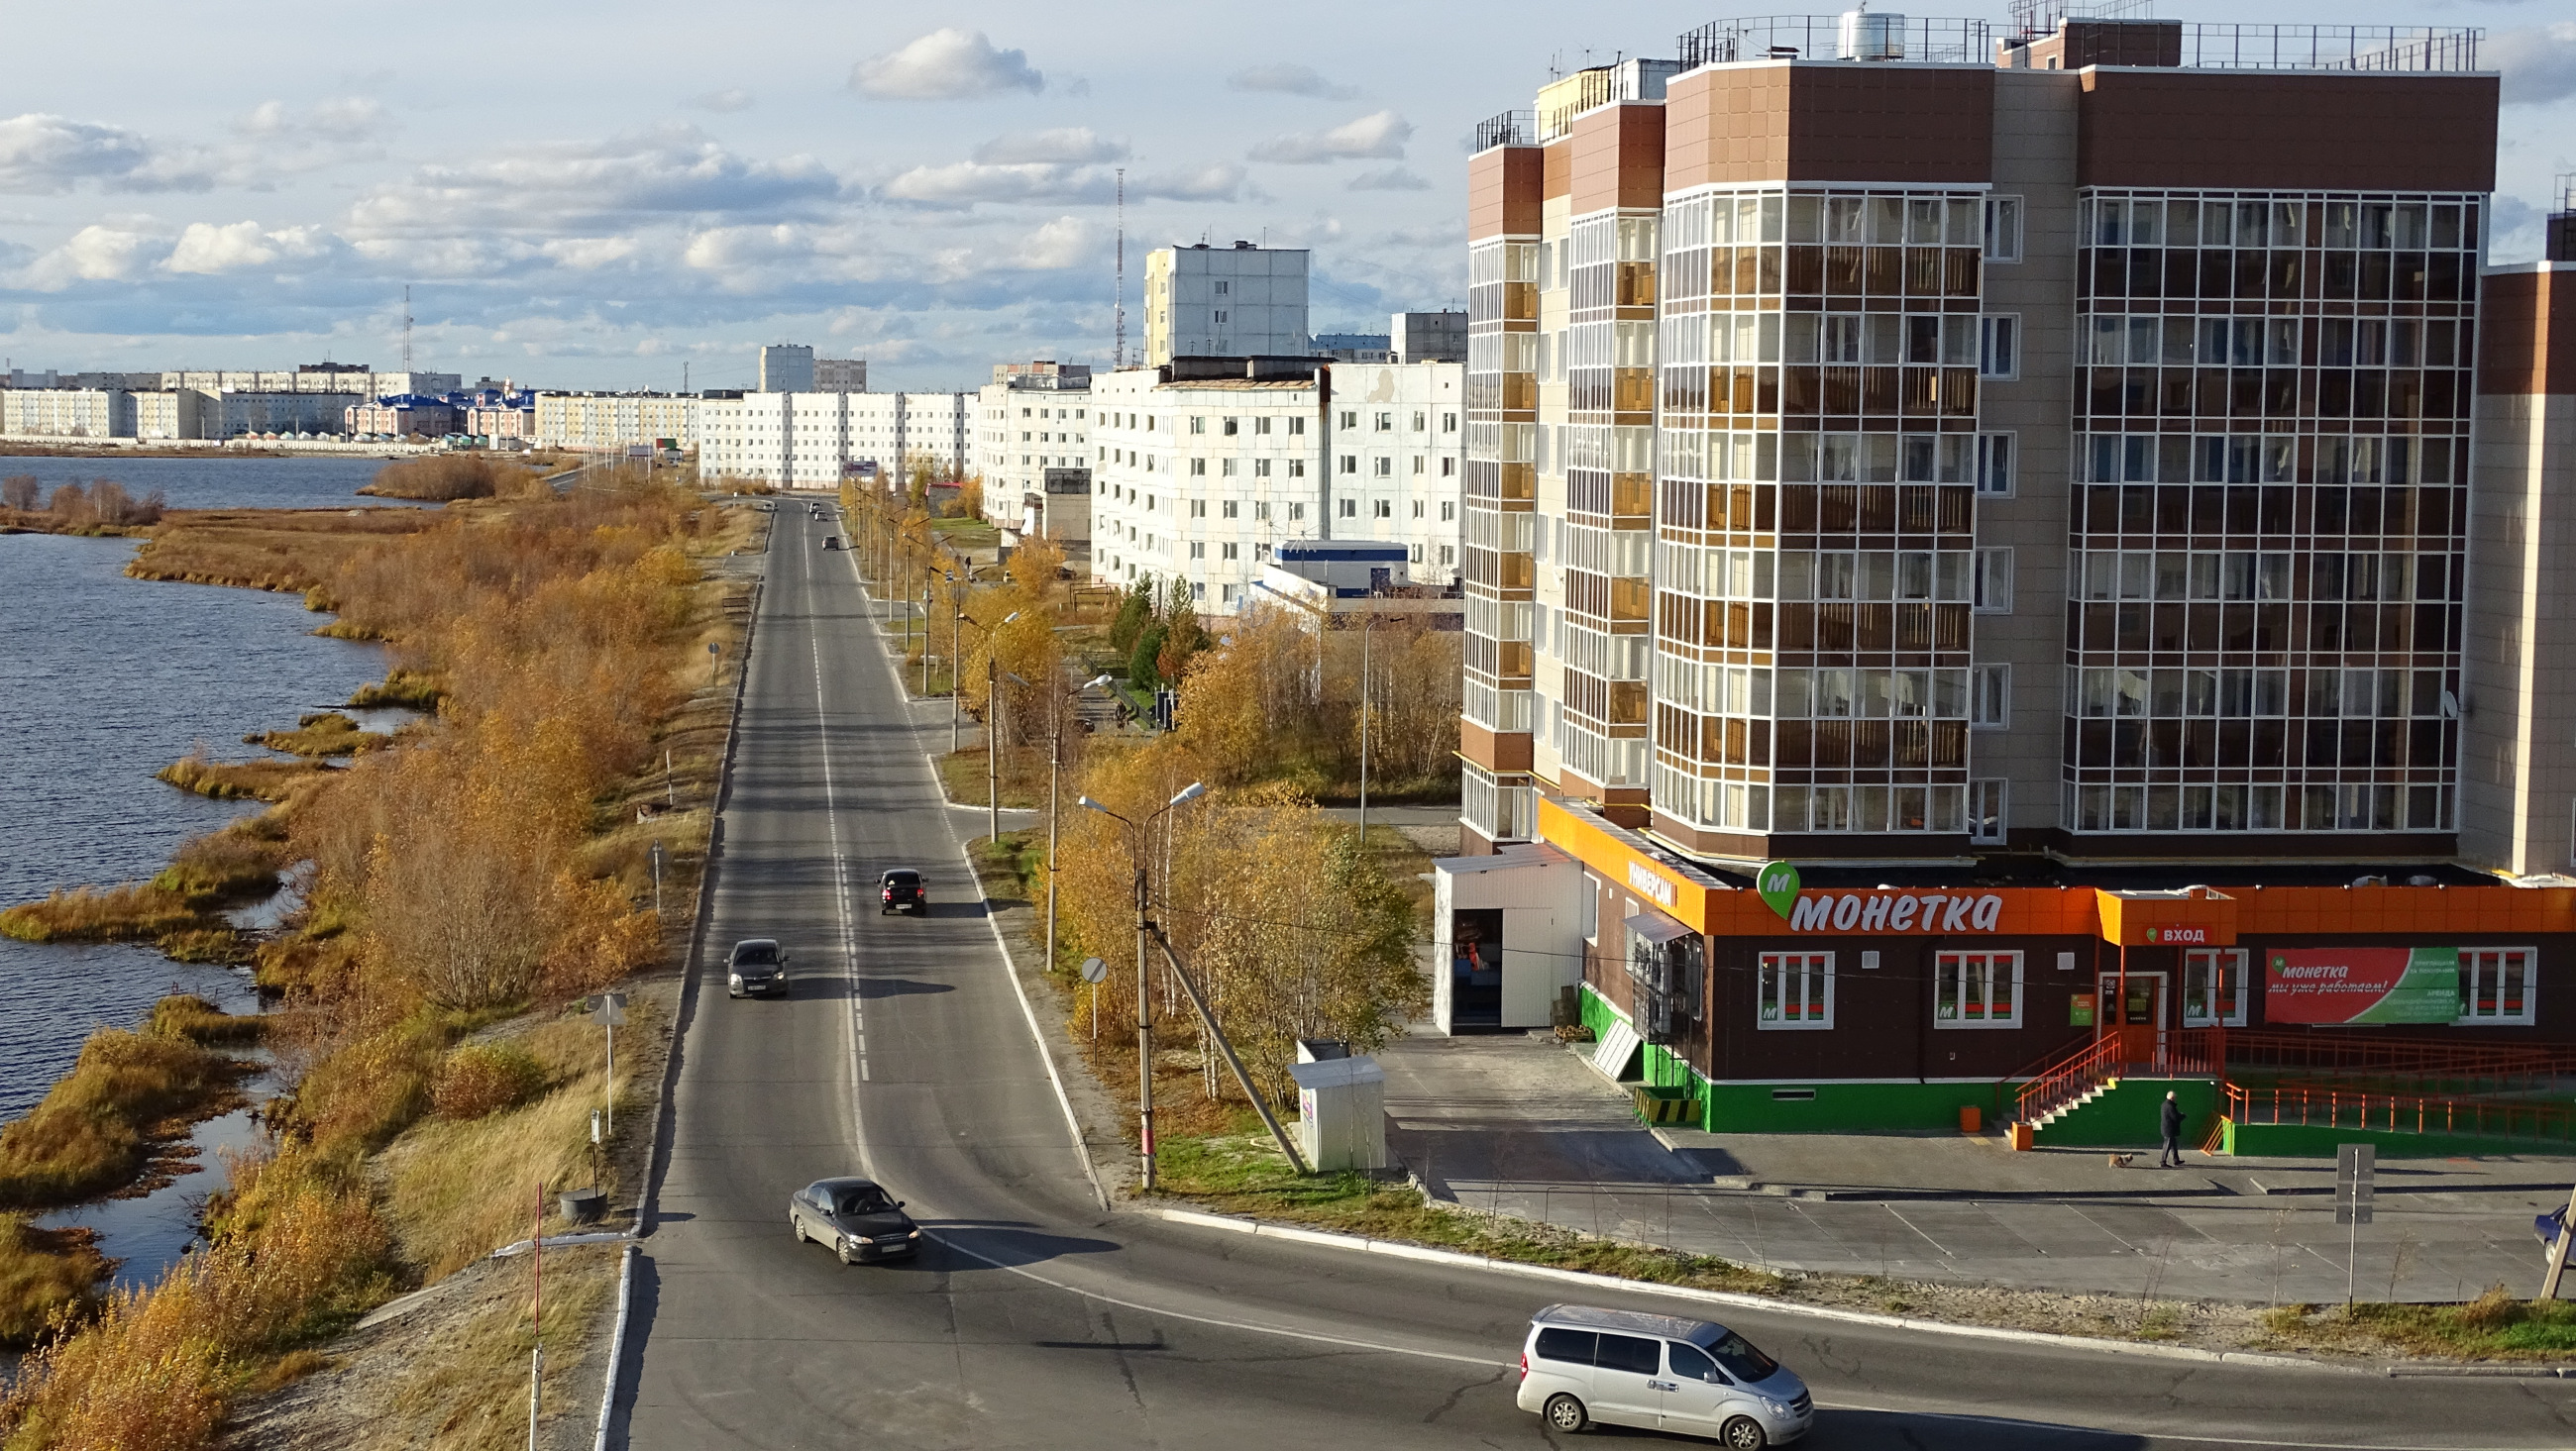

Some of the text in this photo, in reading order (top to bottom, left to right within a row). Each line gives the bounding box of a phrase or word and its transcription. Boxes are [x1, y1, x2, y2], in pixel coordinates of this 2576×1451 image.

[1628, 860, 1673, 908] УНИВЕРСАМ
[2163, 929, 2205, 942] ВХОД
[2290, 984, 2316, 996] уже
[2316, 980, 2389, 996] работаем!
